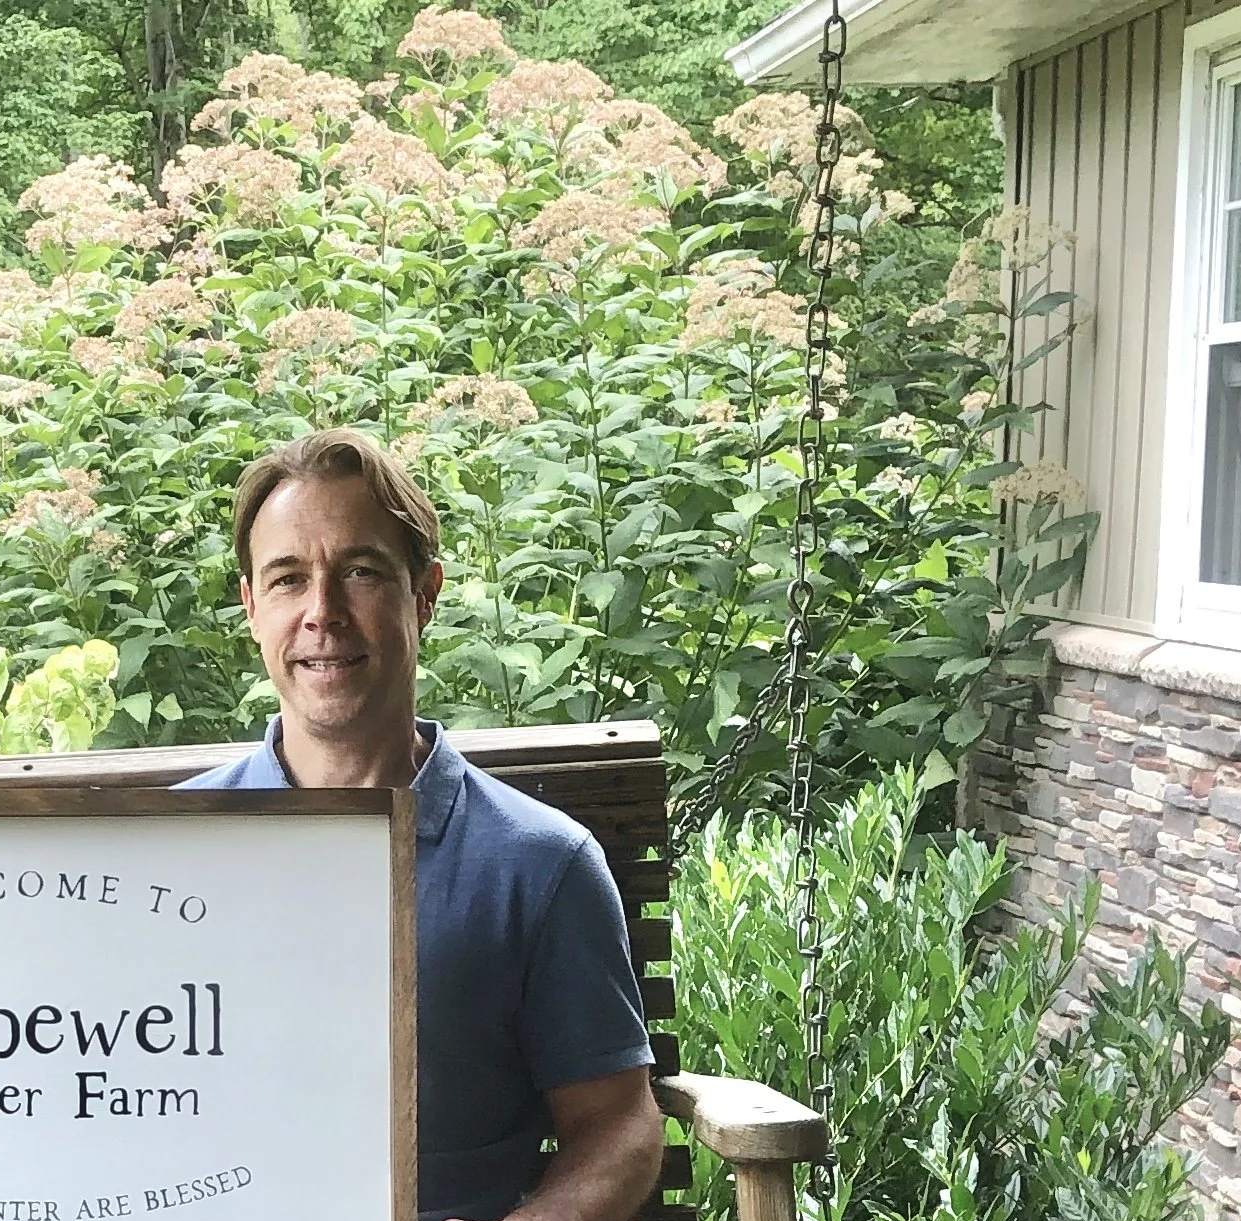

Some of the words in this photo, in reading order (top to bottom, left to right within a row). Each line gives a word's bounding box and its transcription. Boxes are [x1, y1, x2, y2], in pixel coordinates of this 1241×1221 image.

[148, 883, 207, 924] TO
[72, 1070, 200, 1120] Farm
[75, 1194, 132, 1220] ARE
[143, 1165, 252, 1212] BLESSED
